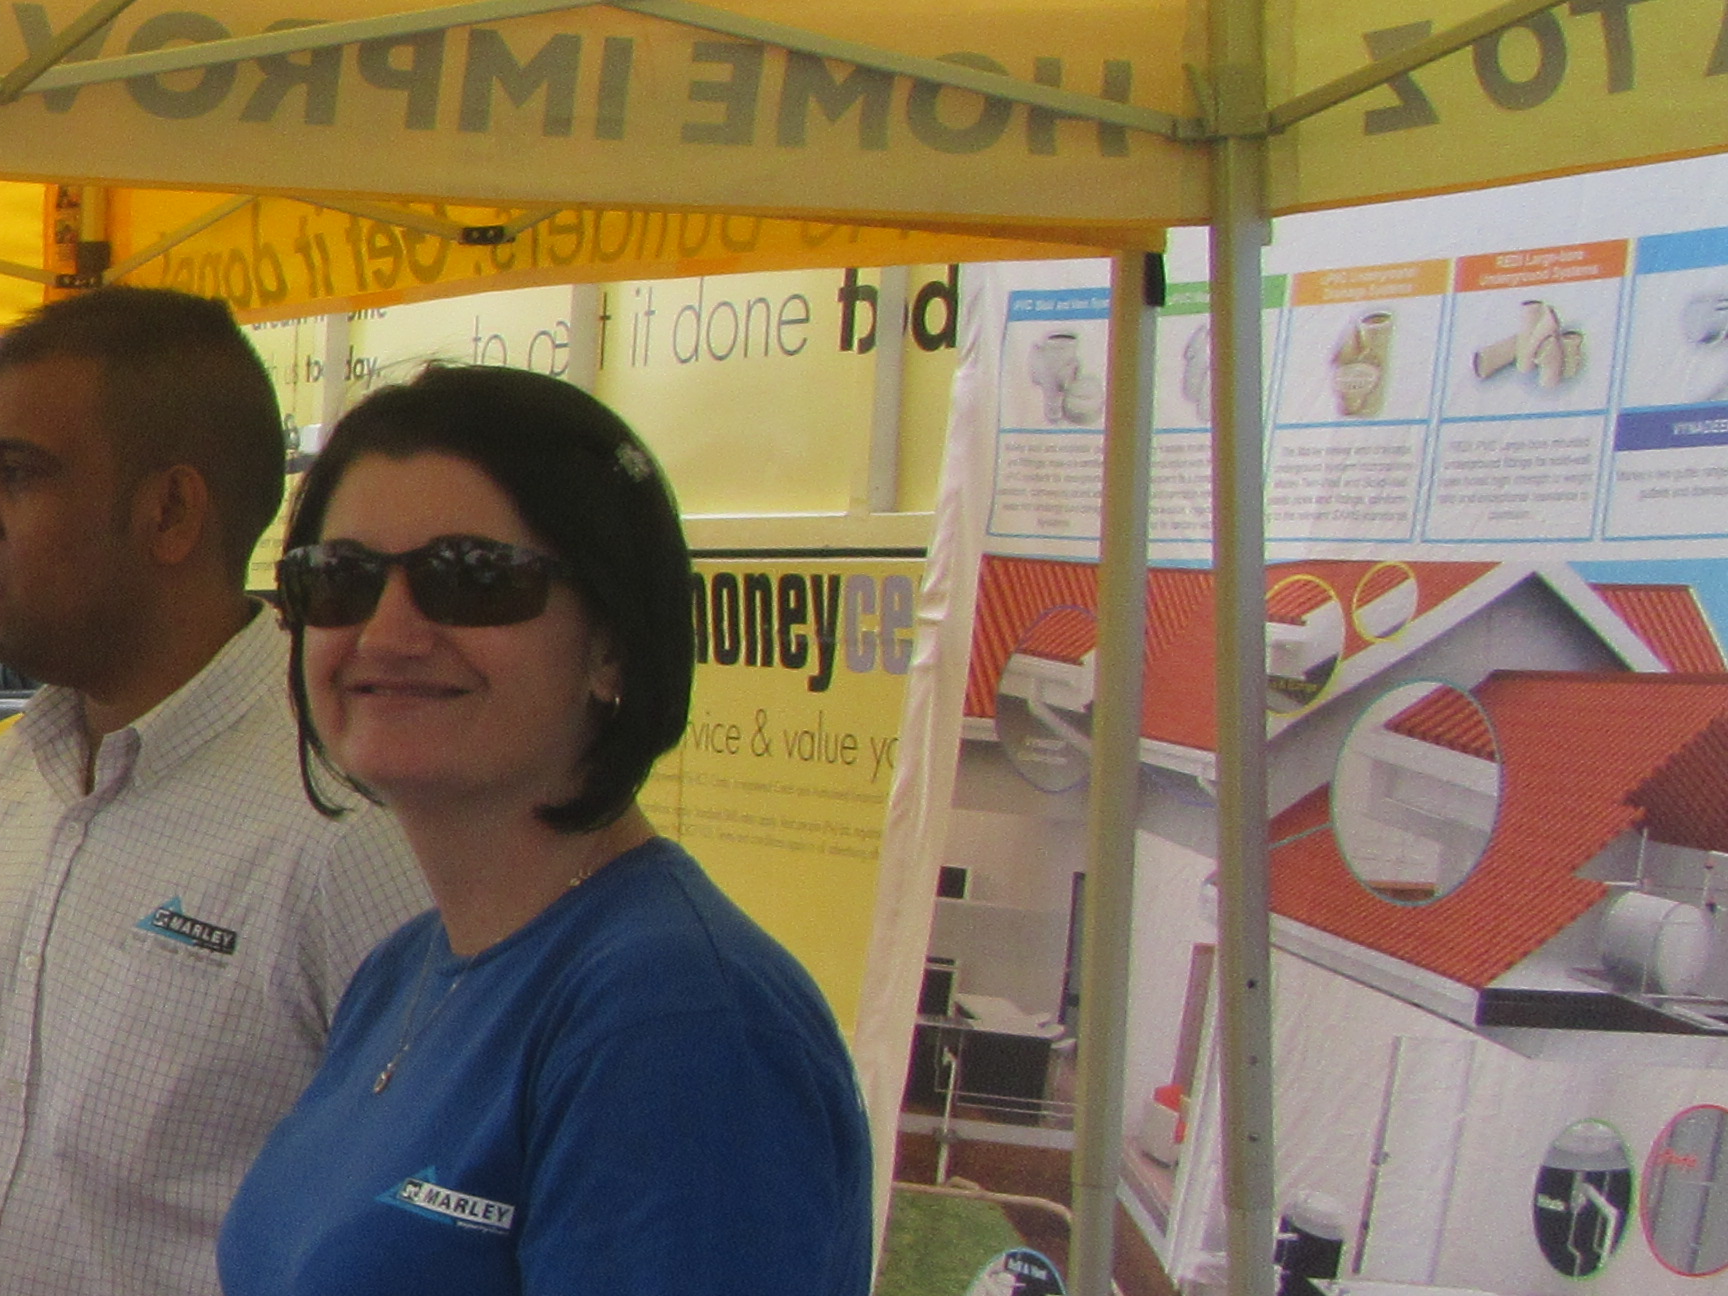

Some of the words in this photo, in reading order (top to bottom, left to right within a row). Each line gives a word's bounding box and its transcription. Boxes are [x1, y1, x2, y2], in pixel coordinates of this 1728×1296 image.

[631, 286, 657, 367] it
[673, 276, 811, 365] done
[693, 571, 919, 693] oneyce
[750, 707, 773, 758] &
[783, 709, 859, 766] value
[165, 913, 235, 948] MARLEY
[424, 1188, 514, 1224] MARLEY
